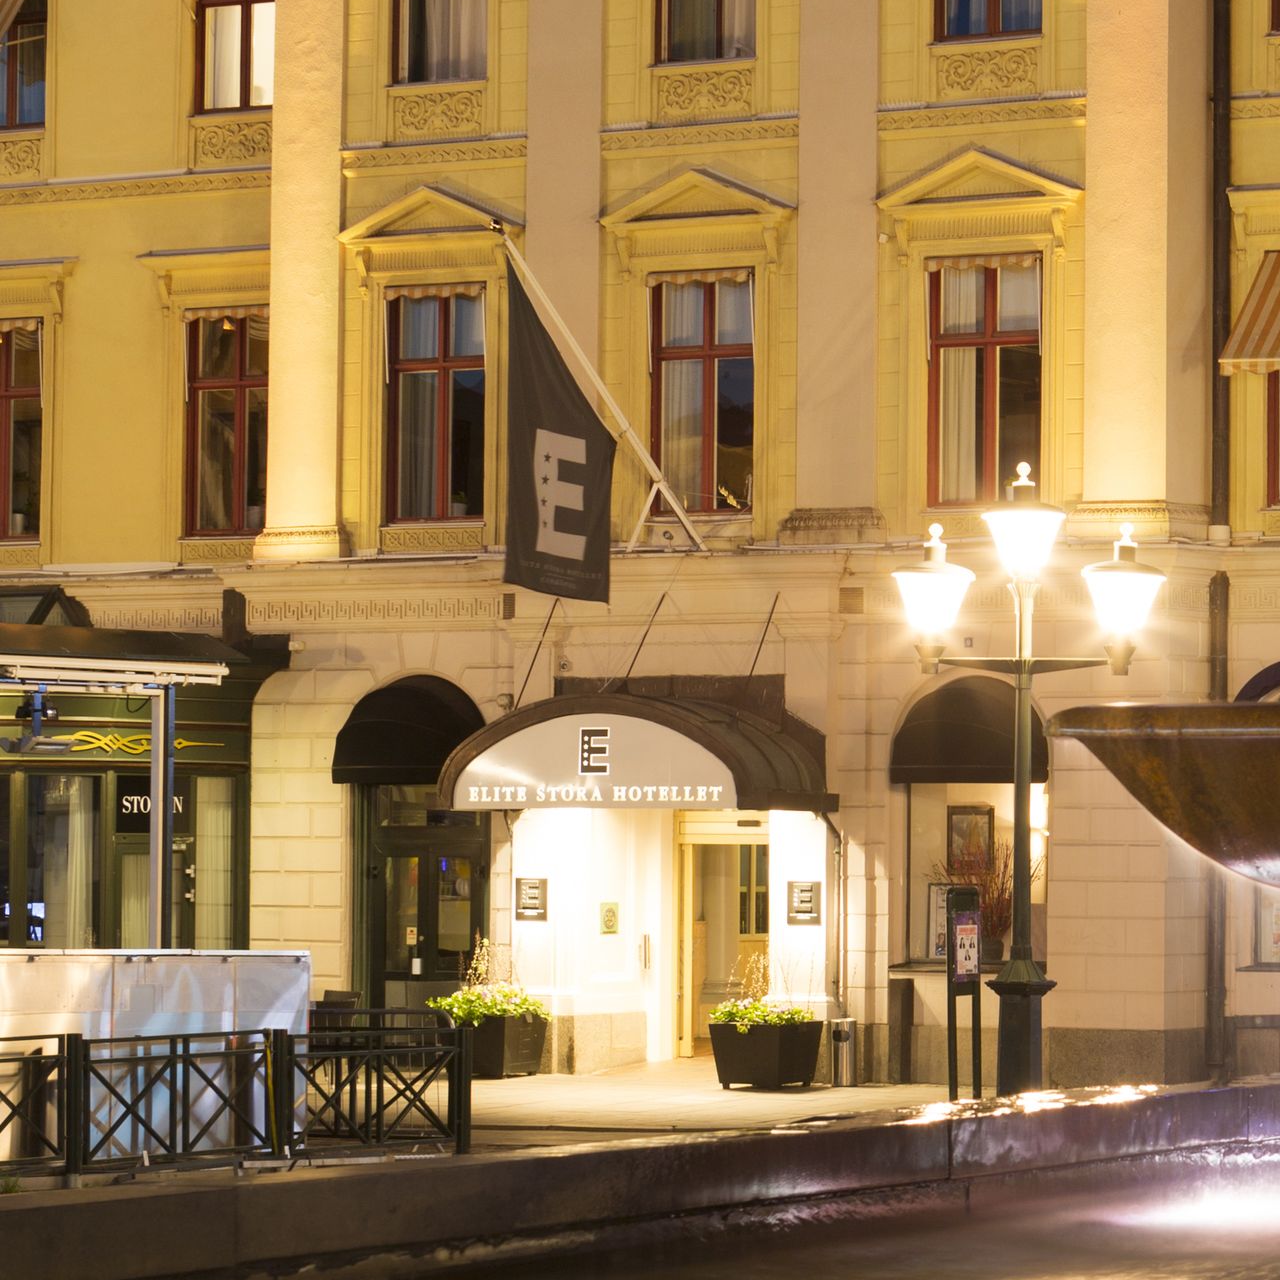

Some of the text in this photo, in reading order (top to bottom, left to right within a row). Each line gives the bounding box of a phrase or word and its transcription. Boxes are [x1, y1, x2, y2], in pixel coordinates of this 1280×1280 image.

[534, 428, 587, 561] E
[578, 726, 611, 775] E
[122, 795, 183, 814] STON
[468, 784, 723, 802] ELITE STORA HOTELLET
